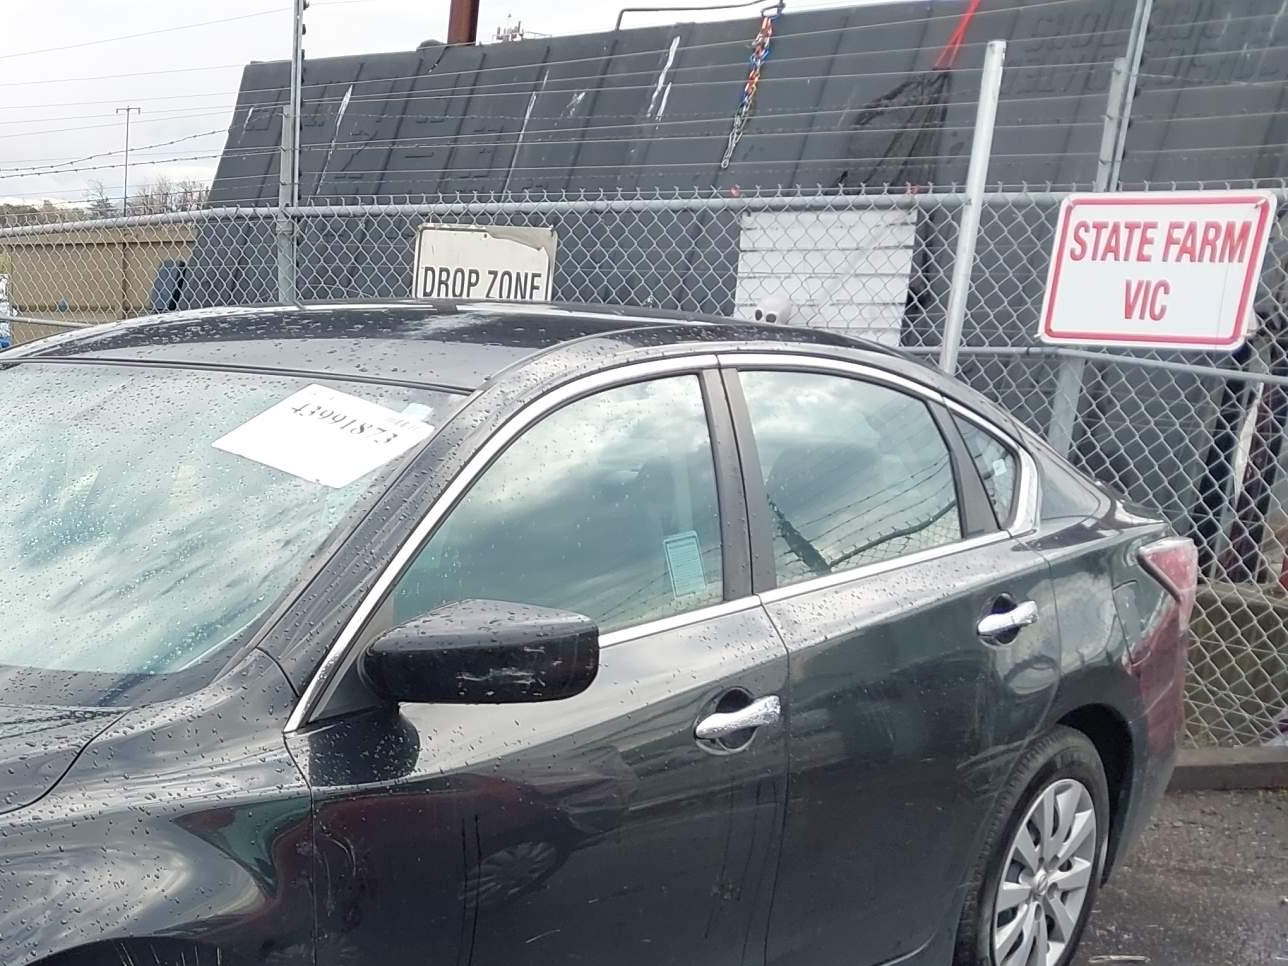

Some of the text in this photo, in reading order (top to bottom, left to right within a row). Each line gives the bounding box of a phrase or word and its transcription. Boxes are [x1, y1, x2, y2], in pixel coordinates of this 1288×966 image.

[1069, 220, 1253, 263] STATE FARM
[422, 266, 480, 298] DROP
[1123, 279, 1171, 321] VIC
[290, 402, 399, 444] 43991873
